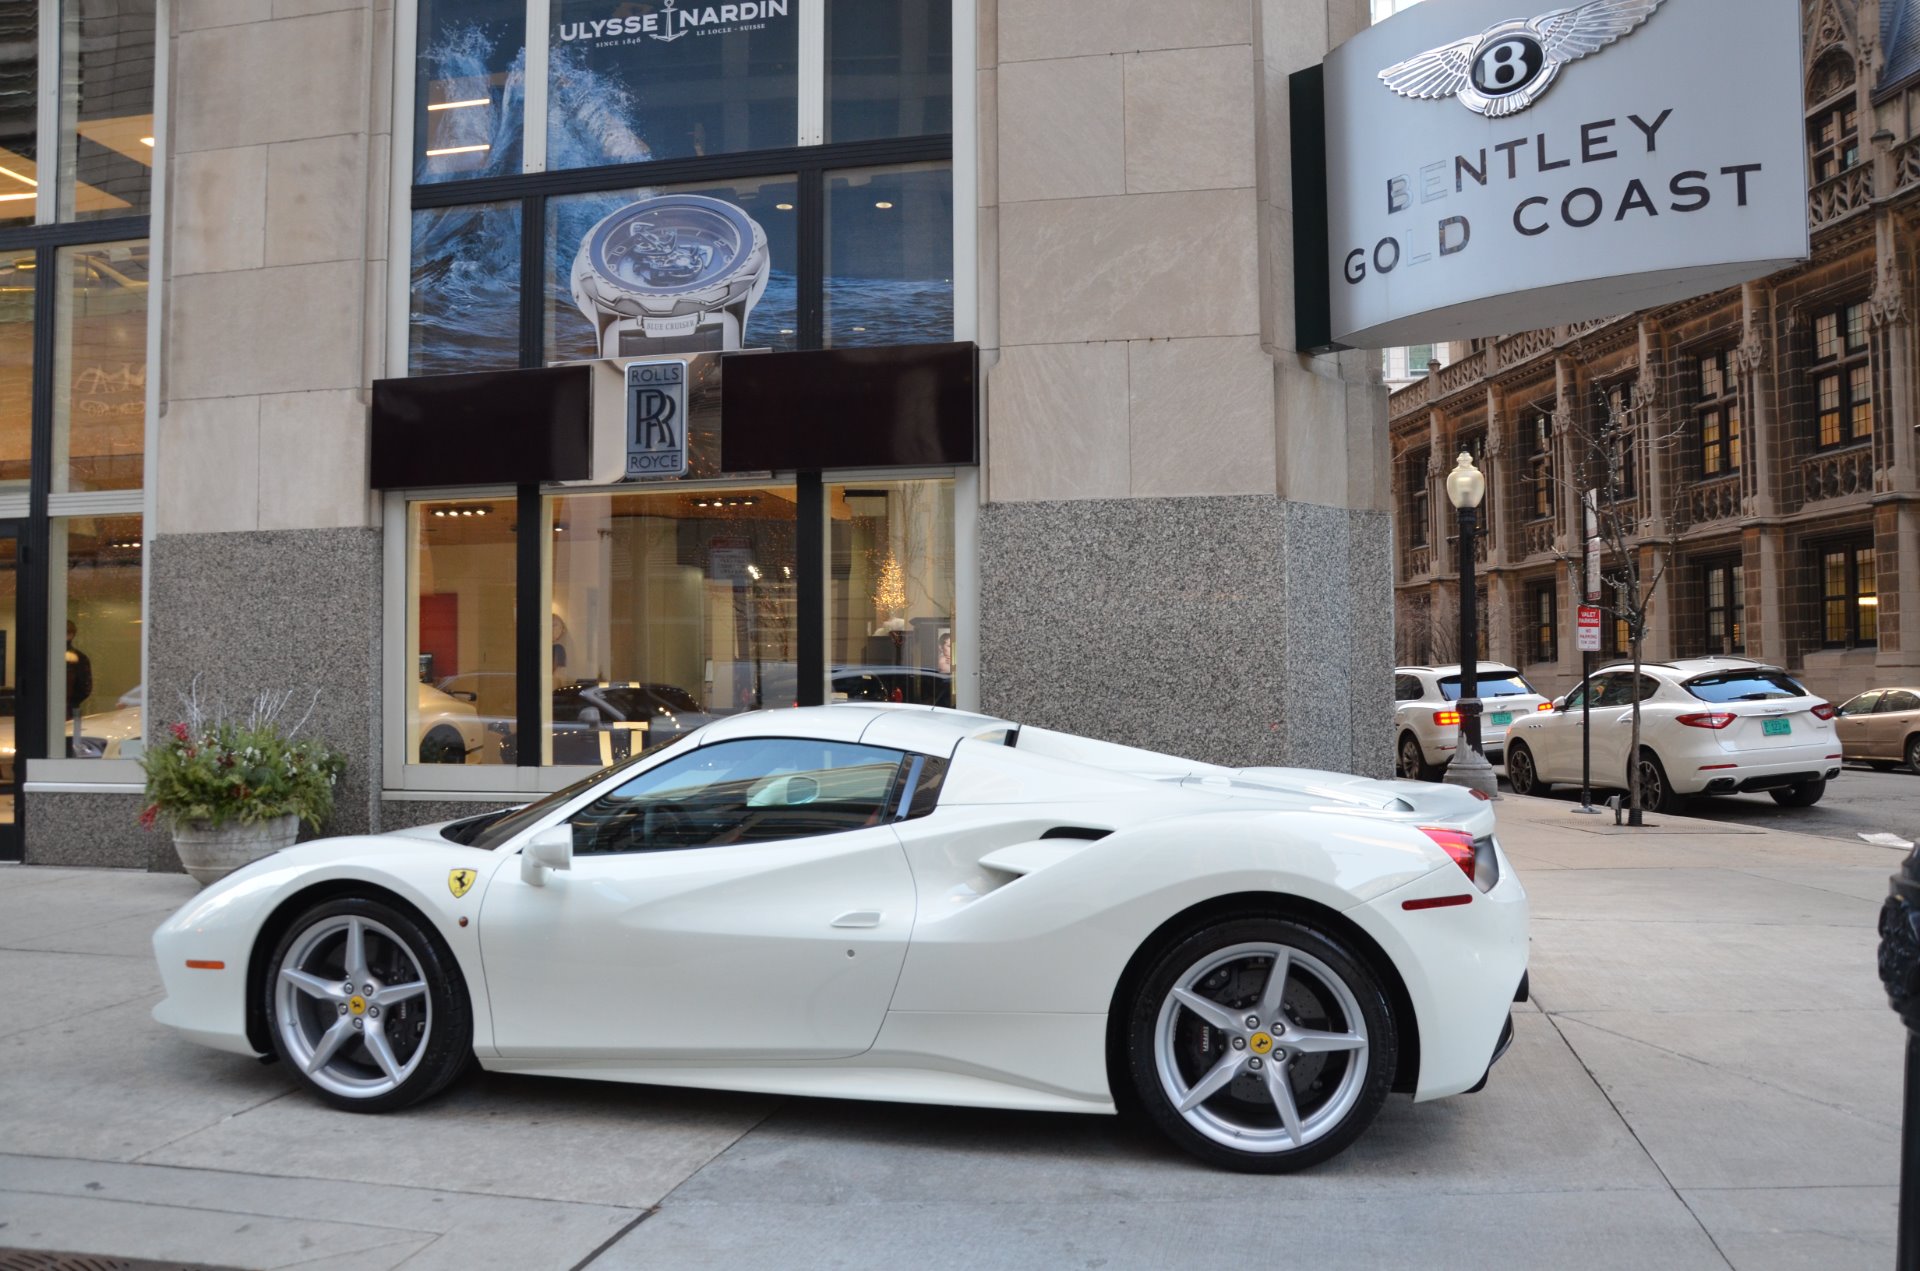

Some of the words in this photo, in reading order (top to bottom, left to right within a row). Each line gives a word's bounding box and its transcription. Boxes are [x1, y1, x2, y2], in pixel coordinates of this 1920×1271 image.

[560, 13, 658, 41] ULYSSE
[680, 0, 788, 27] NARDIN
[708, 27, 732, 35] LOCLE
[740, 23, 766, 31] SUISSE
[622, 37, 641, 45] 1846
[1482, 41, 1528, 90] B
[1387, 108, 1674, 215] BENTLEY
[1344, 215, 1471, 284] GOLD
[1513, 163, 1762, 236] COAST
[646, 322, 664, 331] BLUE
[665, 320, 695, 330] CRUISER
[631, 367, 679, 382] ROLLS
[630, 455, 679, 469] ROYCE
